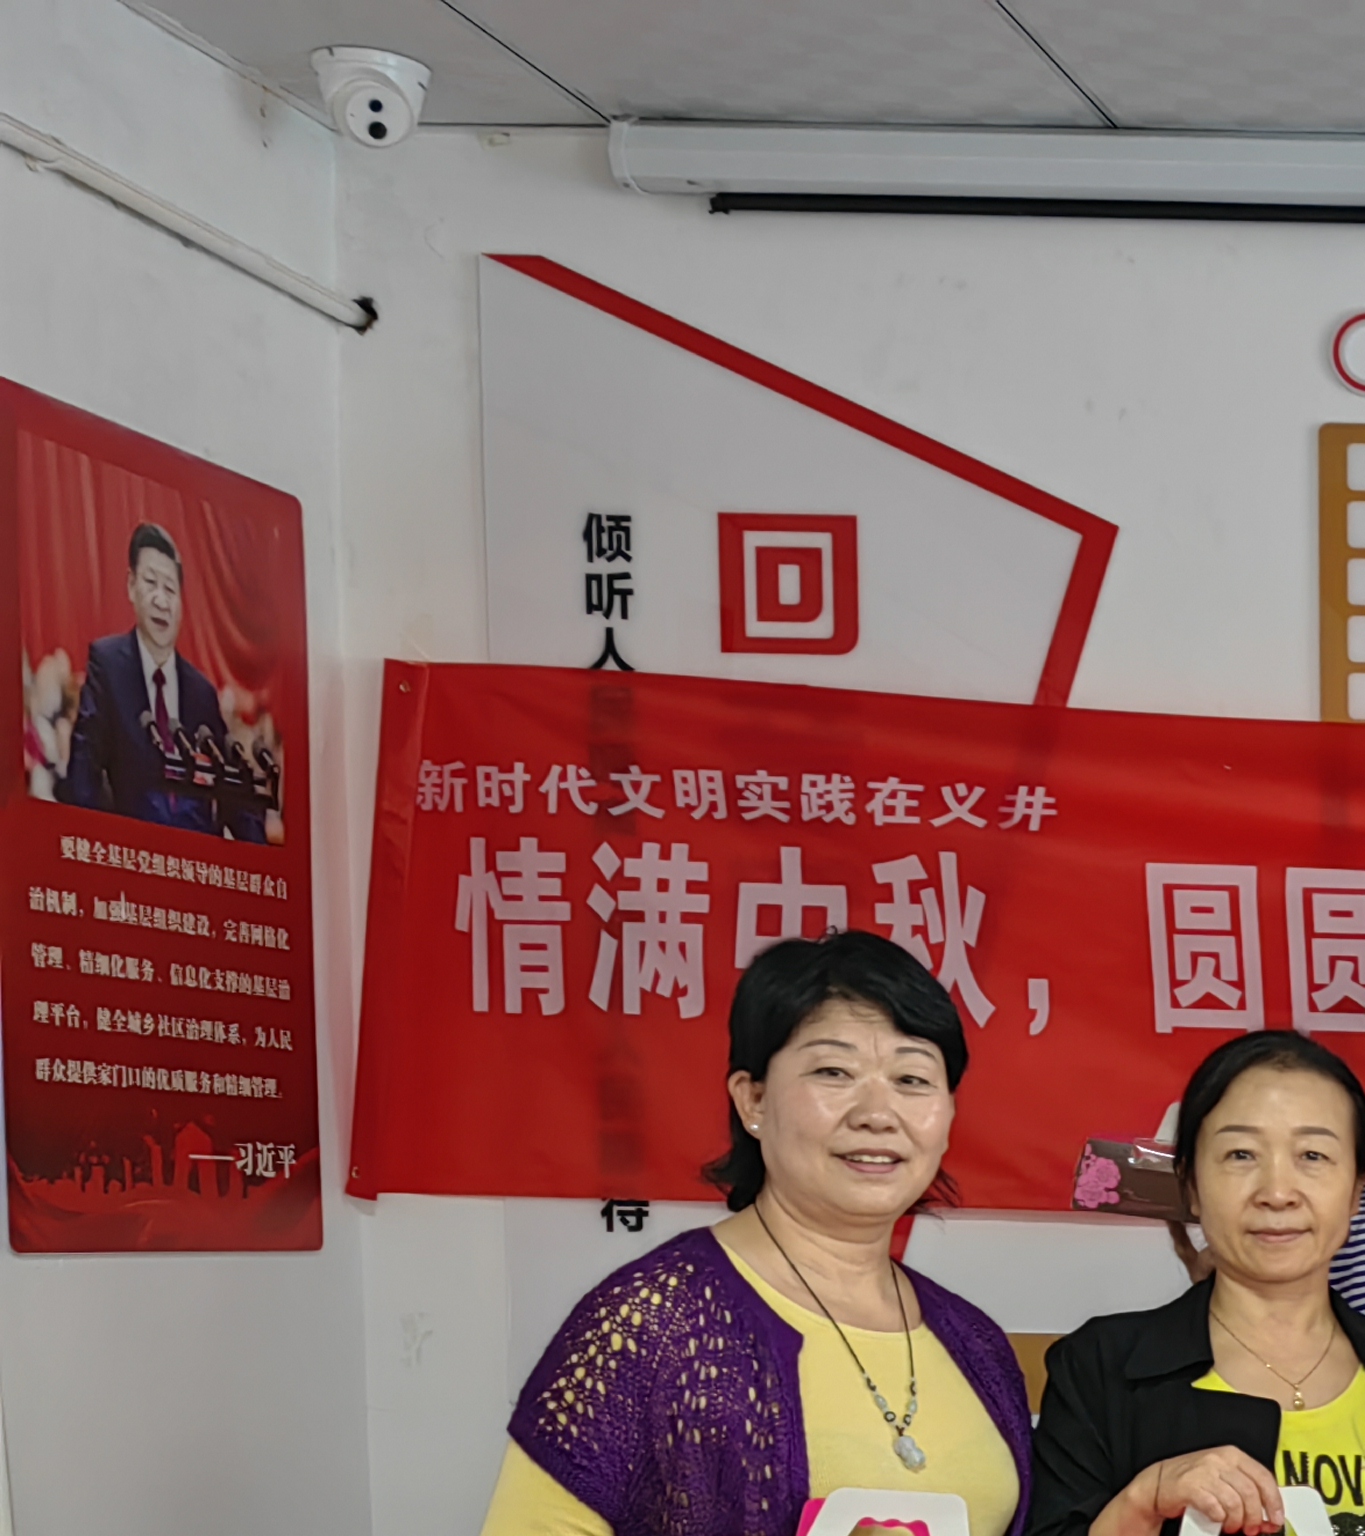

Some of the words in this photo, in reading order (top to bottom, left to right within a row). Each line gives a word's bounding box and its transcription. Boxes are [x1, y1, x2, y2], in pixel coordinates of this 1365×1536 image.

[582, 511, 636, 672] 倾听人
[415, 760, 1058, 832] 新时代文明实践在义井
